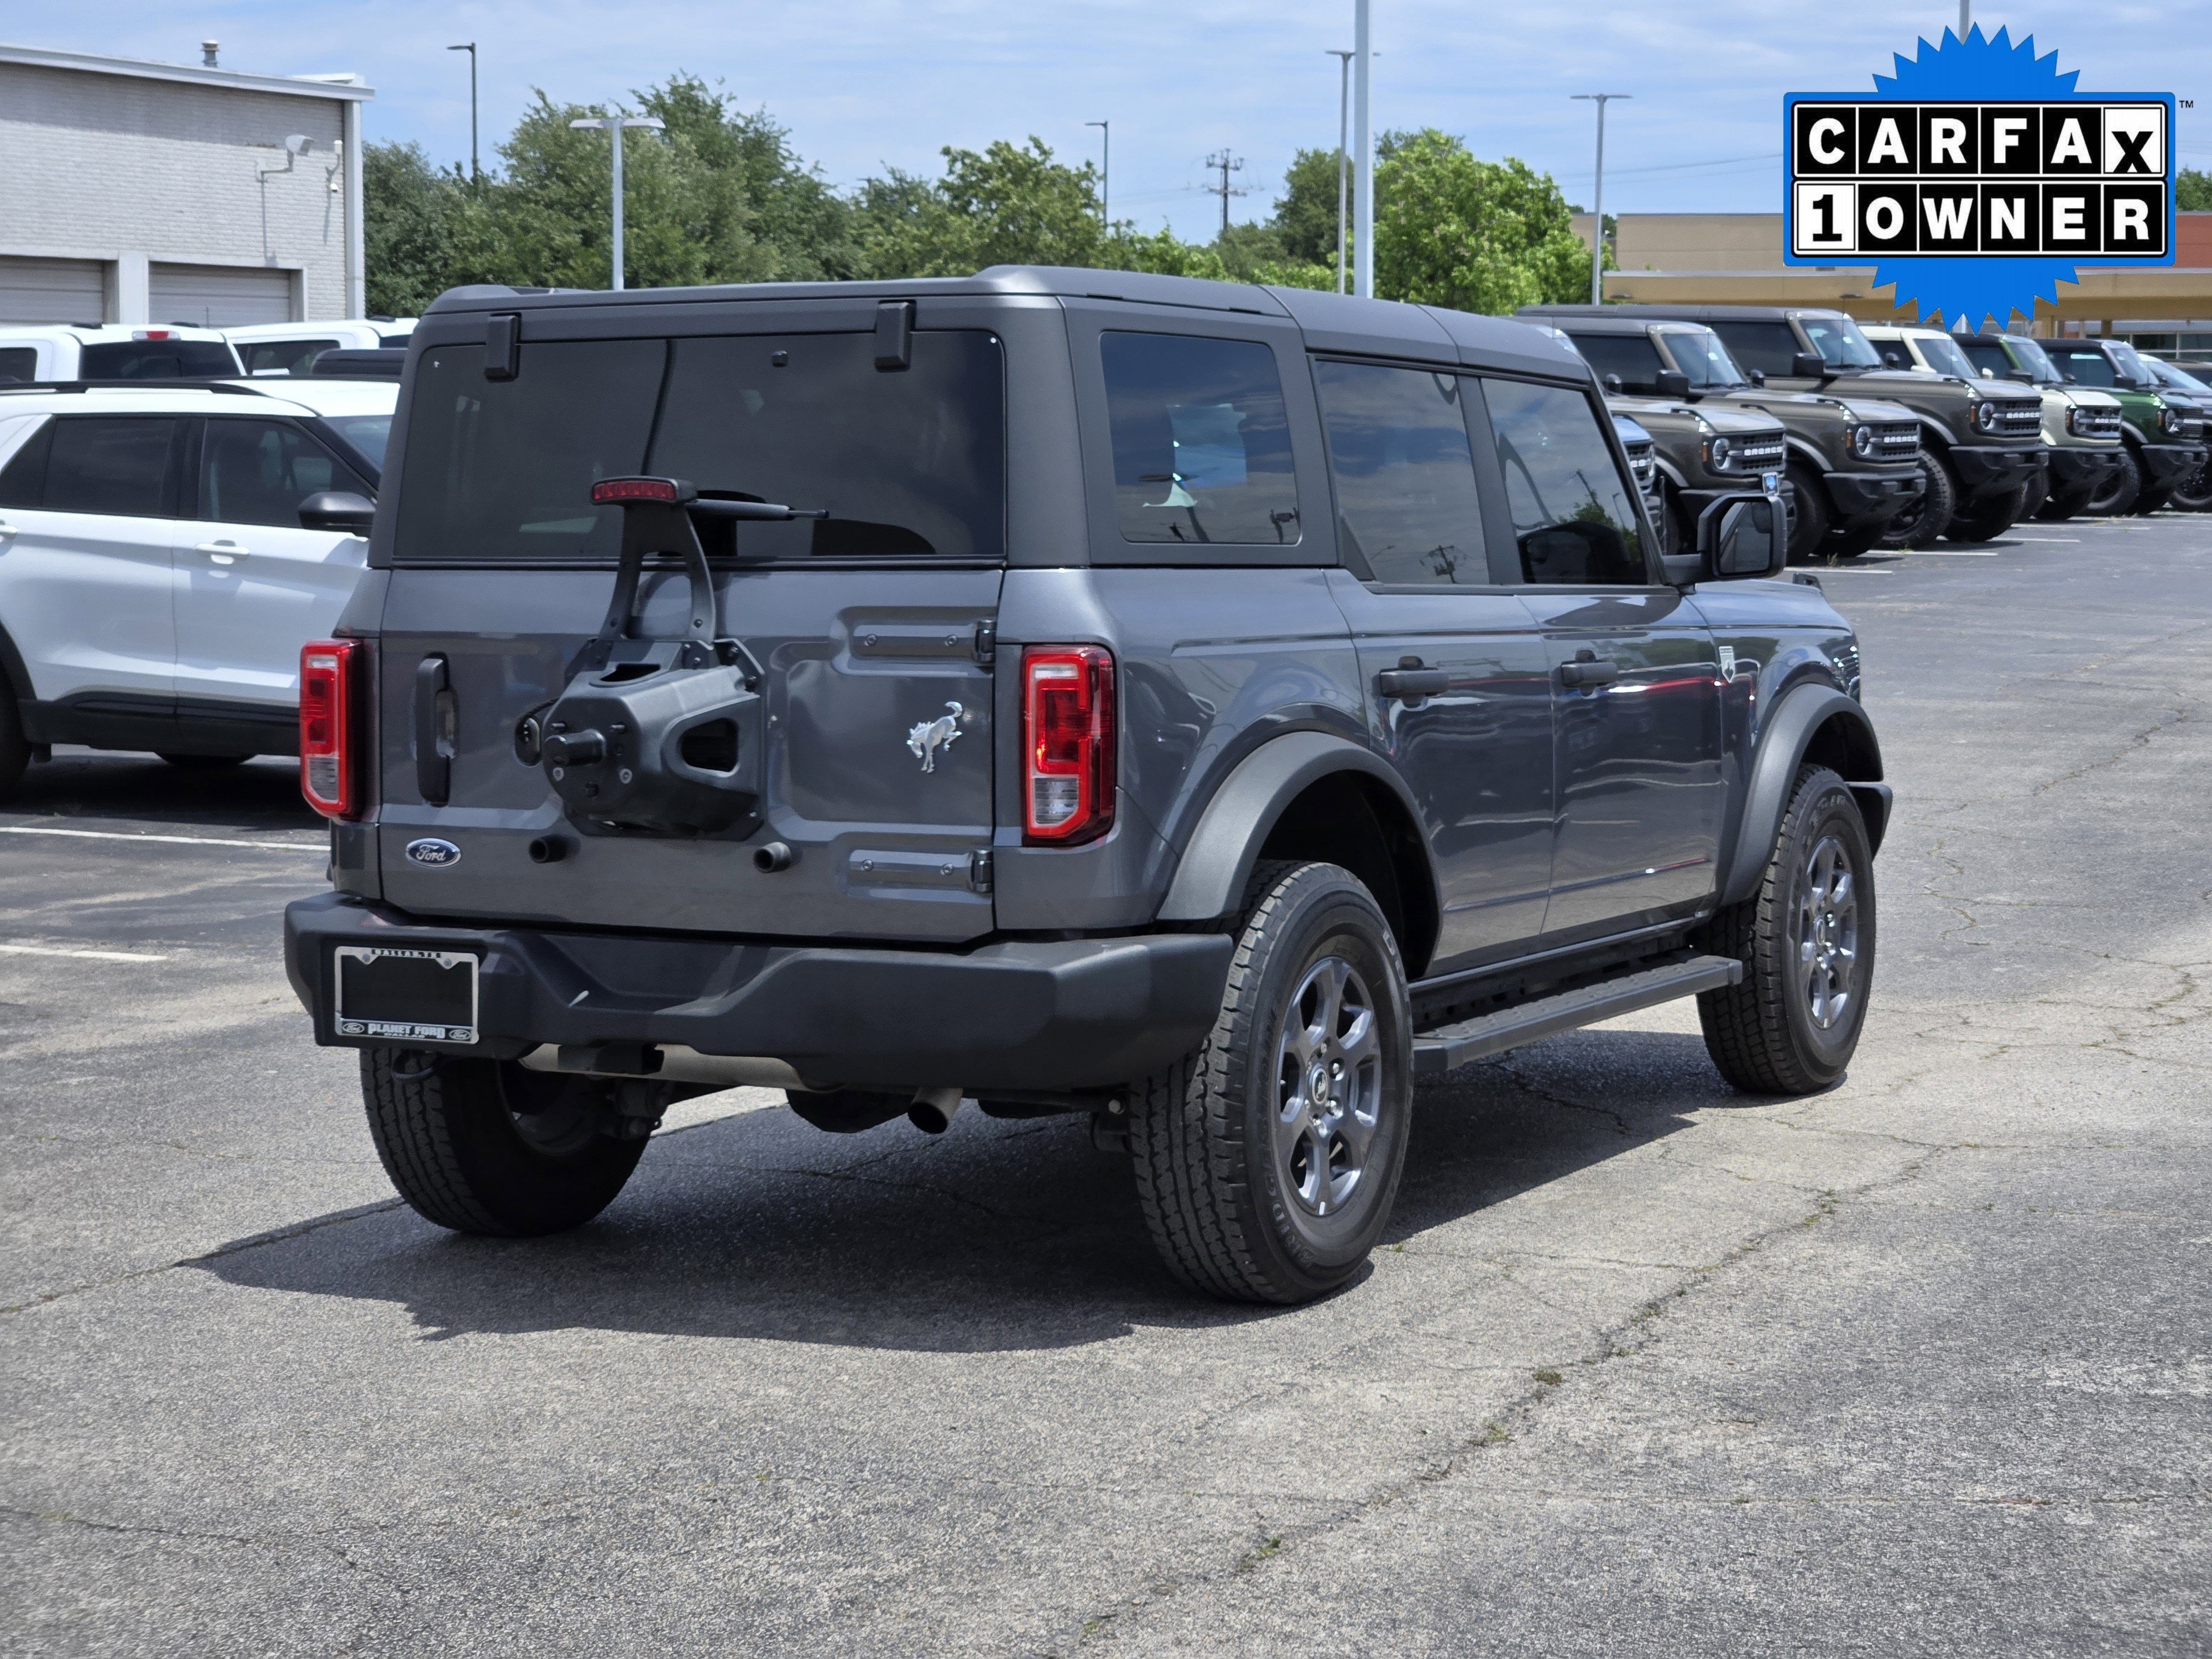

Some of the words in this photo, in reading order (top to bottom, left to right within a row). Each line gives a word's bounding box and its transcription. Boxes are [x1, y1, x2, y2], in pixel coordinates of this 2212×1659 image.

[416, 844, 447, 861] Ford
[368, 1023, 412, 1035] PLANET
[415, 1026, 446, 1039] FORD
